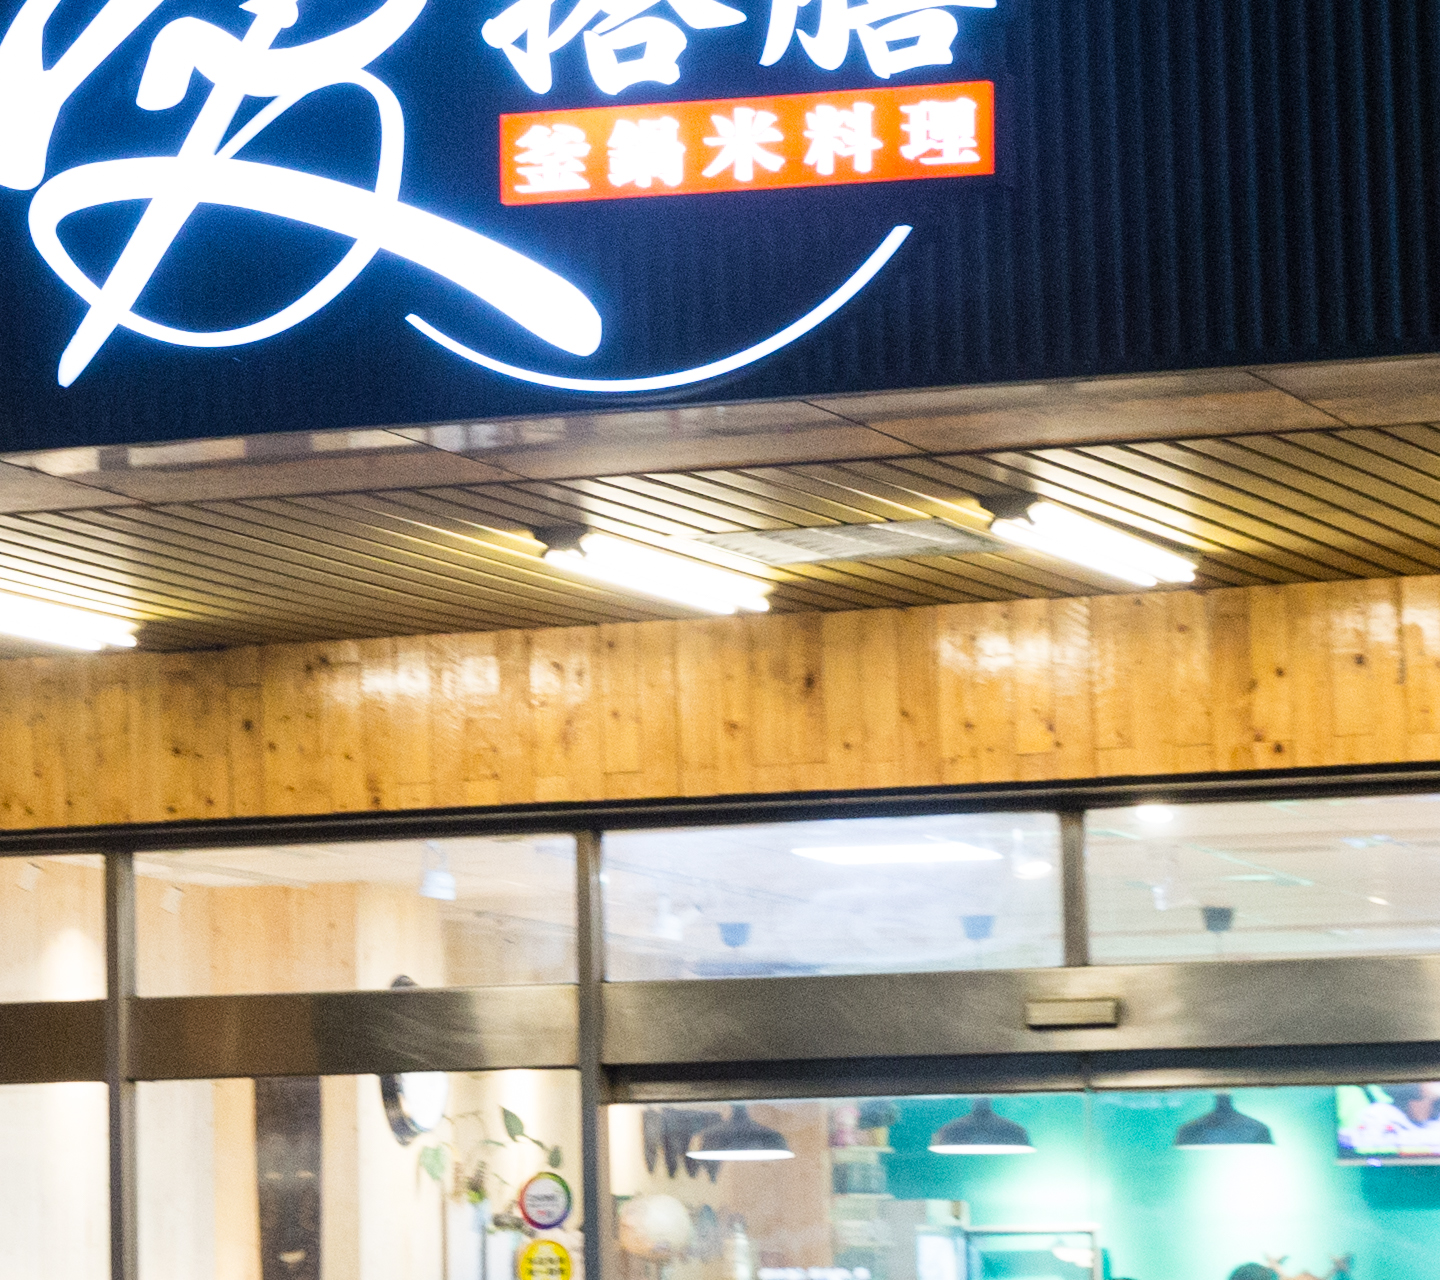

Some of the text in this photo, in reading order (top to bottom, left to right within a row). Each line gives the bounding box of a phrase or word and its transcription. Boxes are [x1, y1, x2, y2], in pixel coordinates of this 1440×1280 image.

[512, 97, 983, 193] 釜鍋米料理
